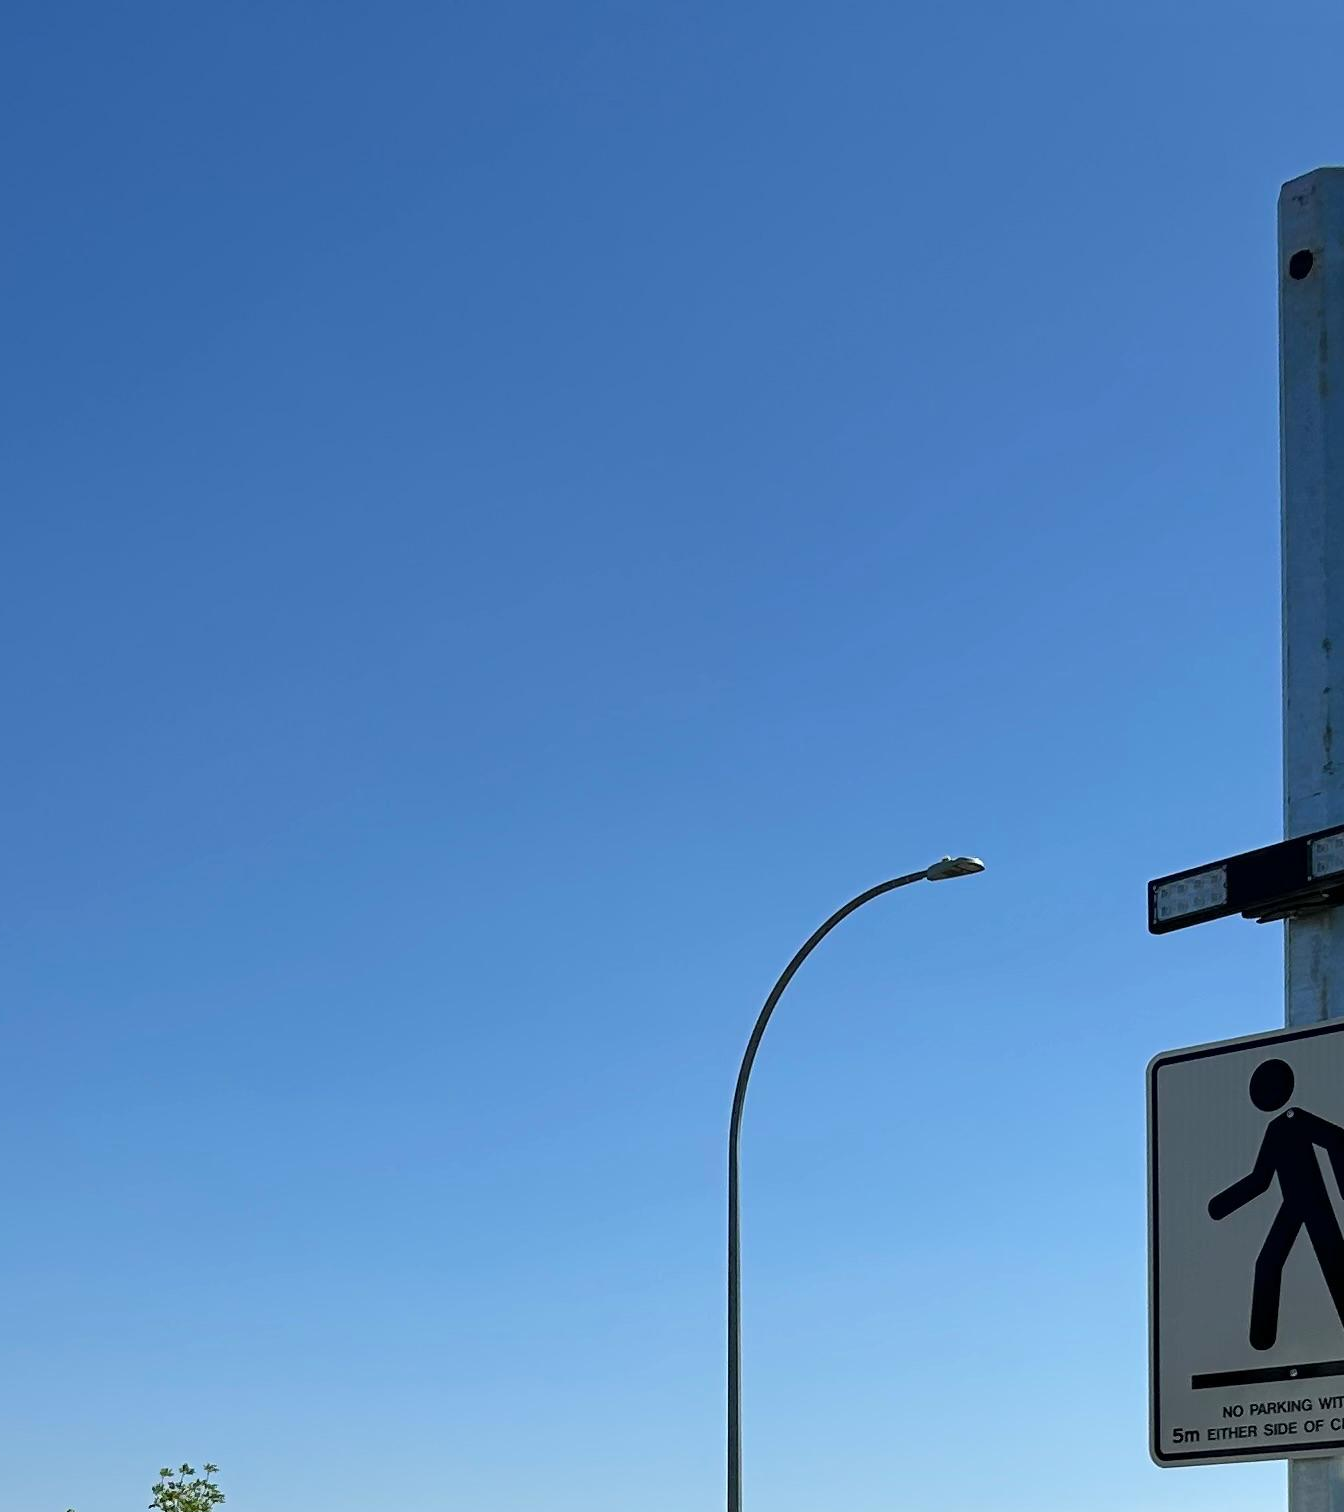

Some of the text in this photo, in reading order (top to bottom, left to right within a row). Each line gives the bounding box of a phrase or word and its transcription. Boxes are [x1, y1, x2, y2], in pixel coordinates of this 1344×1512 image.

[1222, 1405, 1244, 1418] NO
[1250, 1399, 1313, 1416] PARKING
[1172, 1428, 1201, 1443] 5m
[1207, 1425, 1258, 1440] EITHER
[1263, 1422, 1298, 1436] SIDE
[1304, 1420, 1324, 1433] OF
